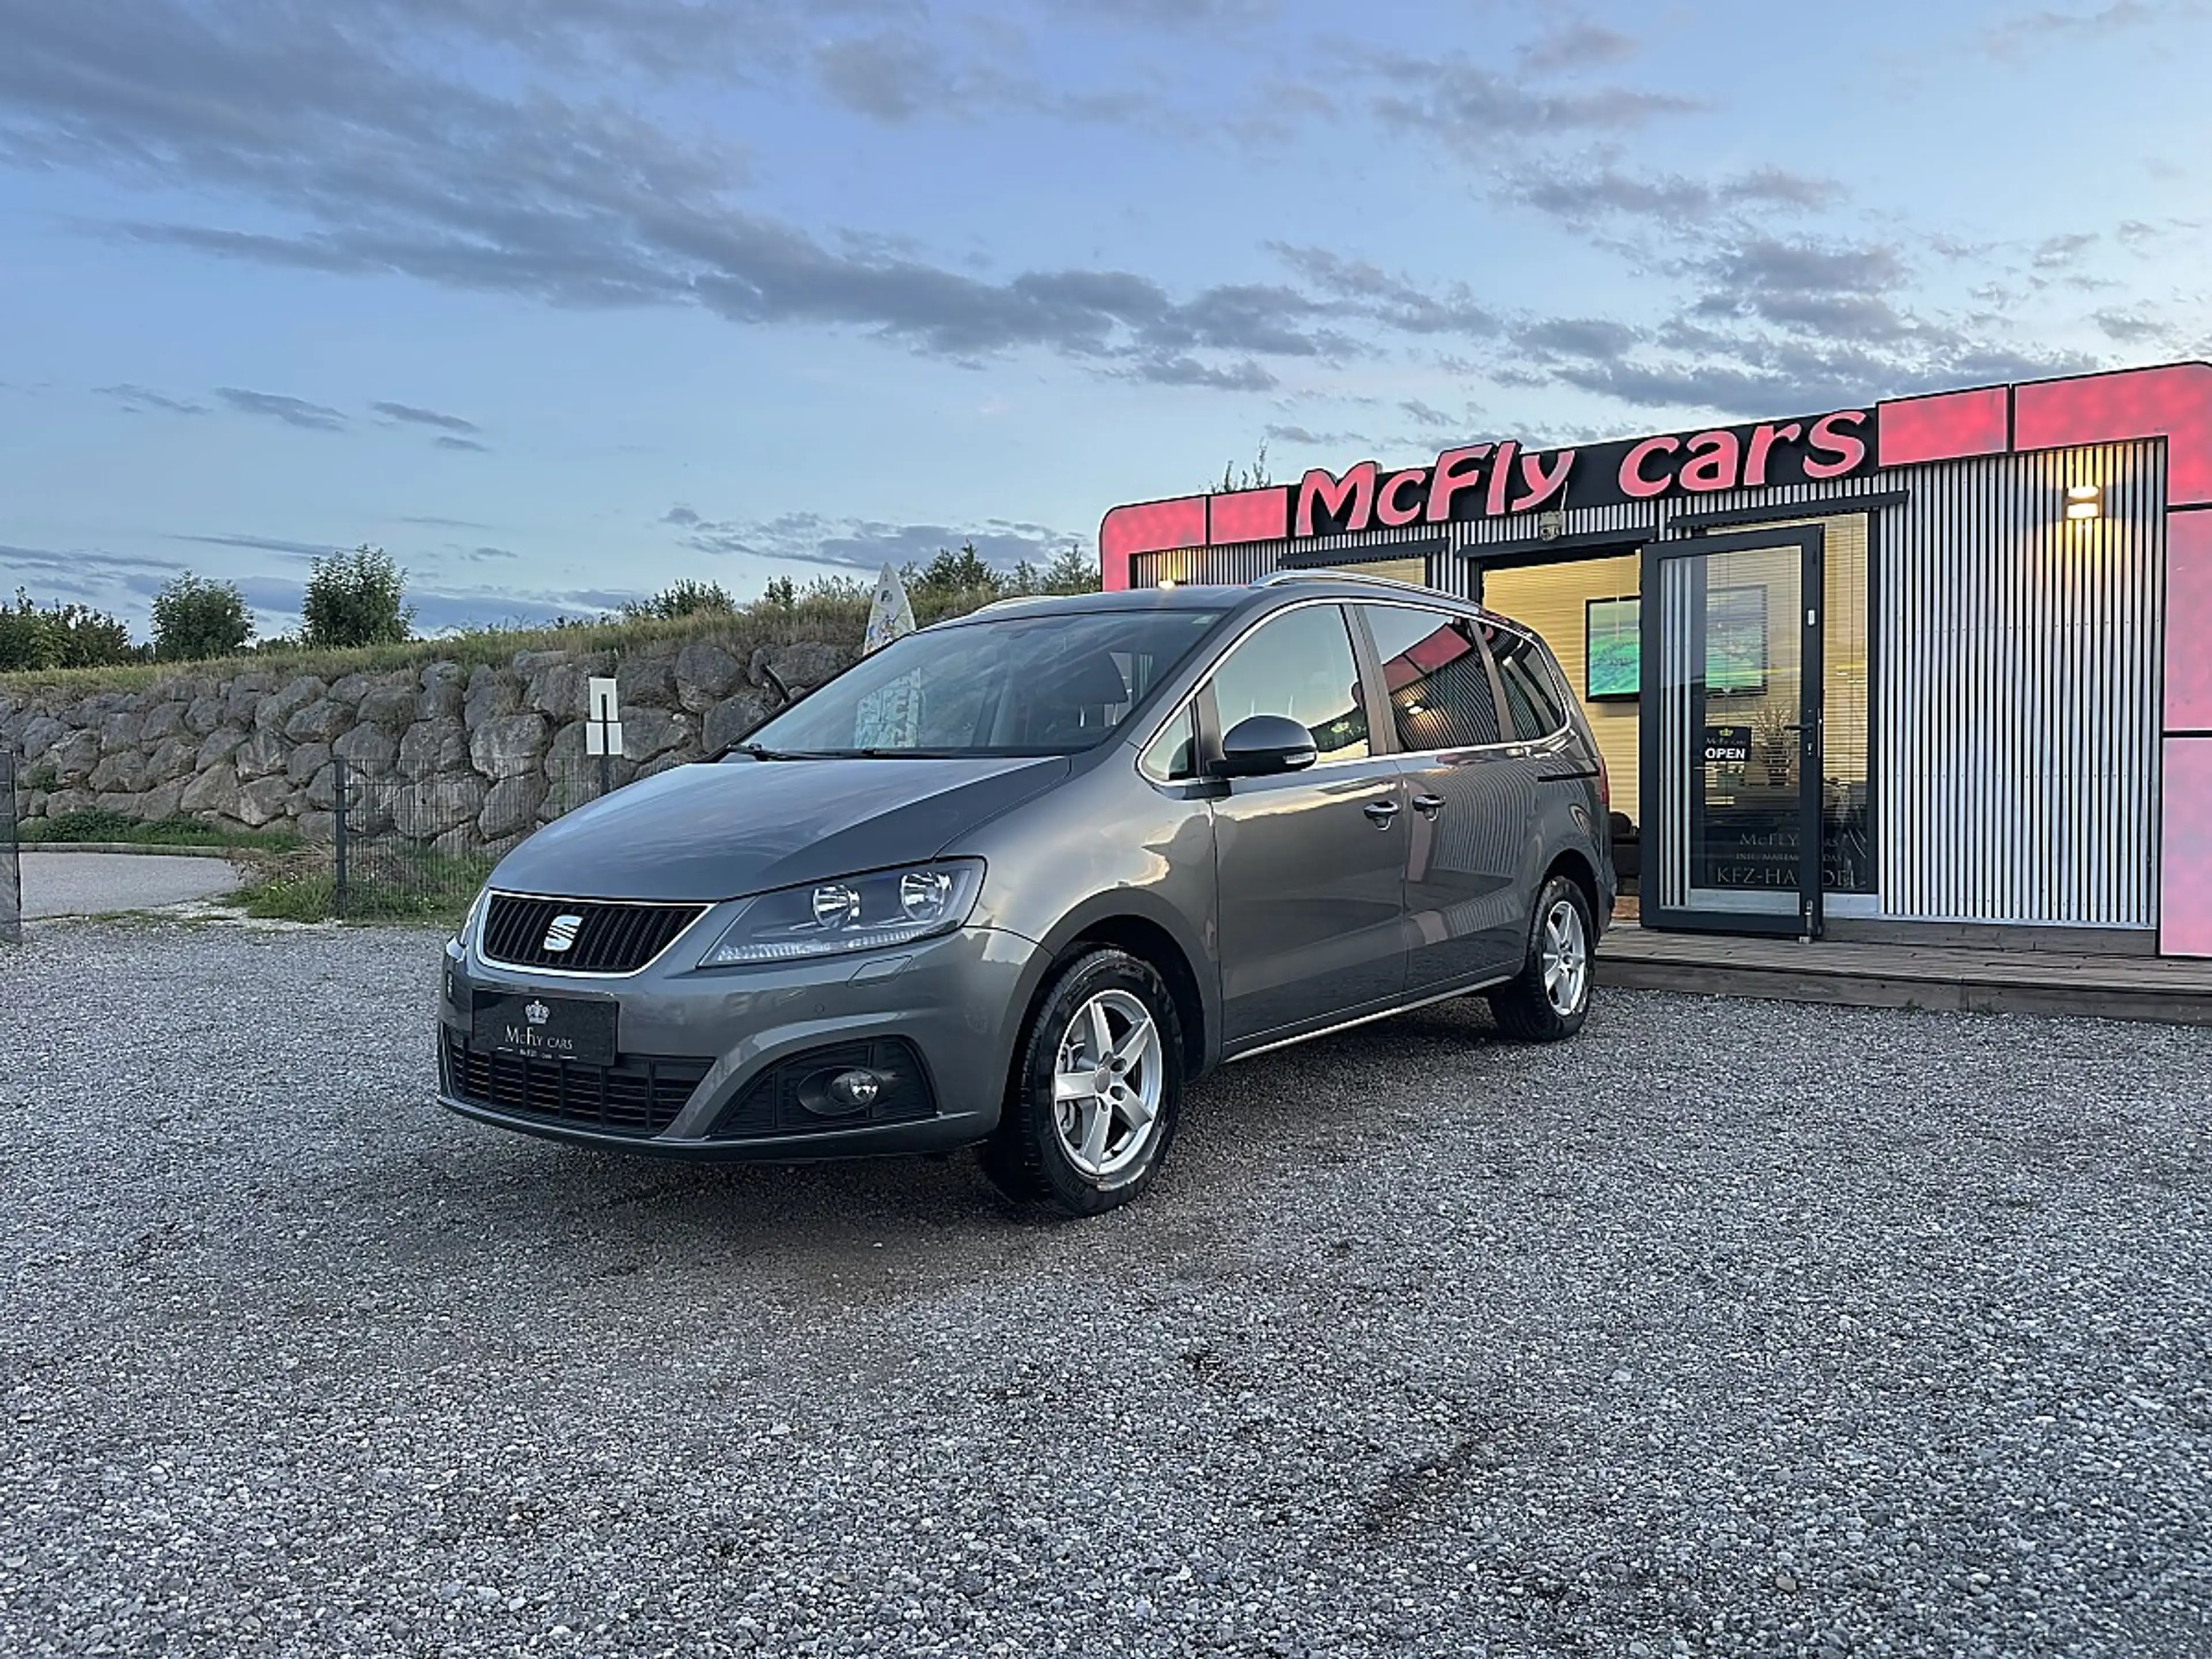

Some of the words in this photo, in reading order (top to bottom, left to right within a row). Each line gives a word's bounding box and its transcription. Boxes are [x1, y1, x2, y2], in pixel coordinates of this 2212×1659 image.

[1294, 440, 1575, 536] McFly
[1616, 411, 1868, 498] cars
[1705, 747, 1746, 759] OPEN
[547, 1036, 573, 1050] CARS
